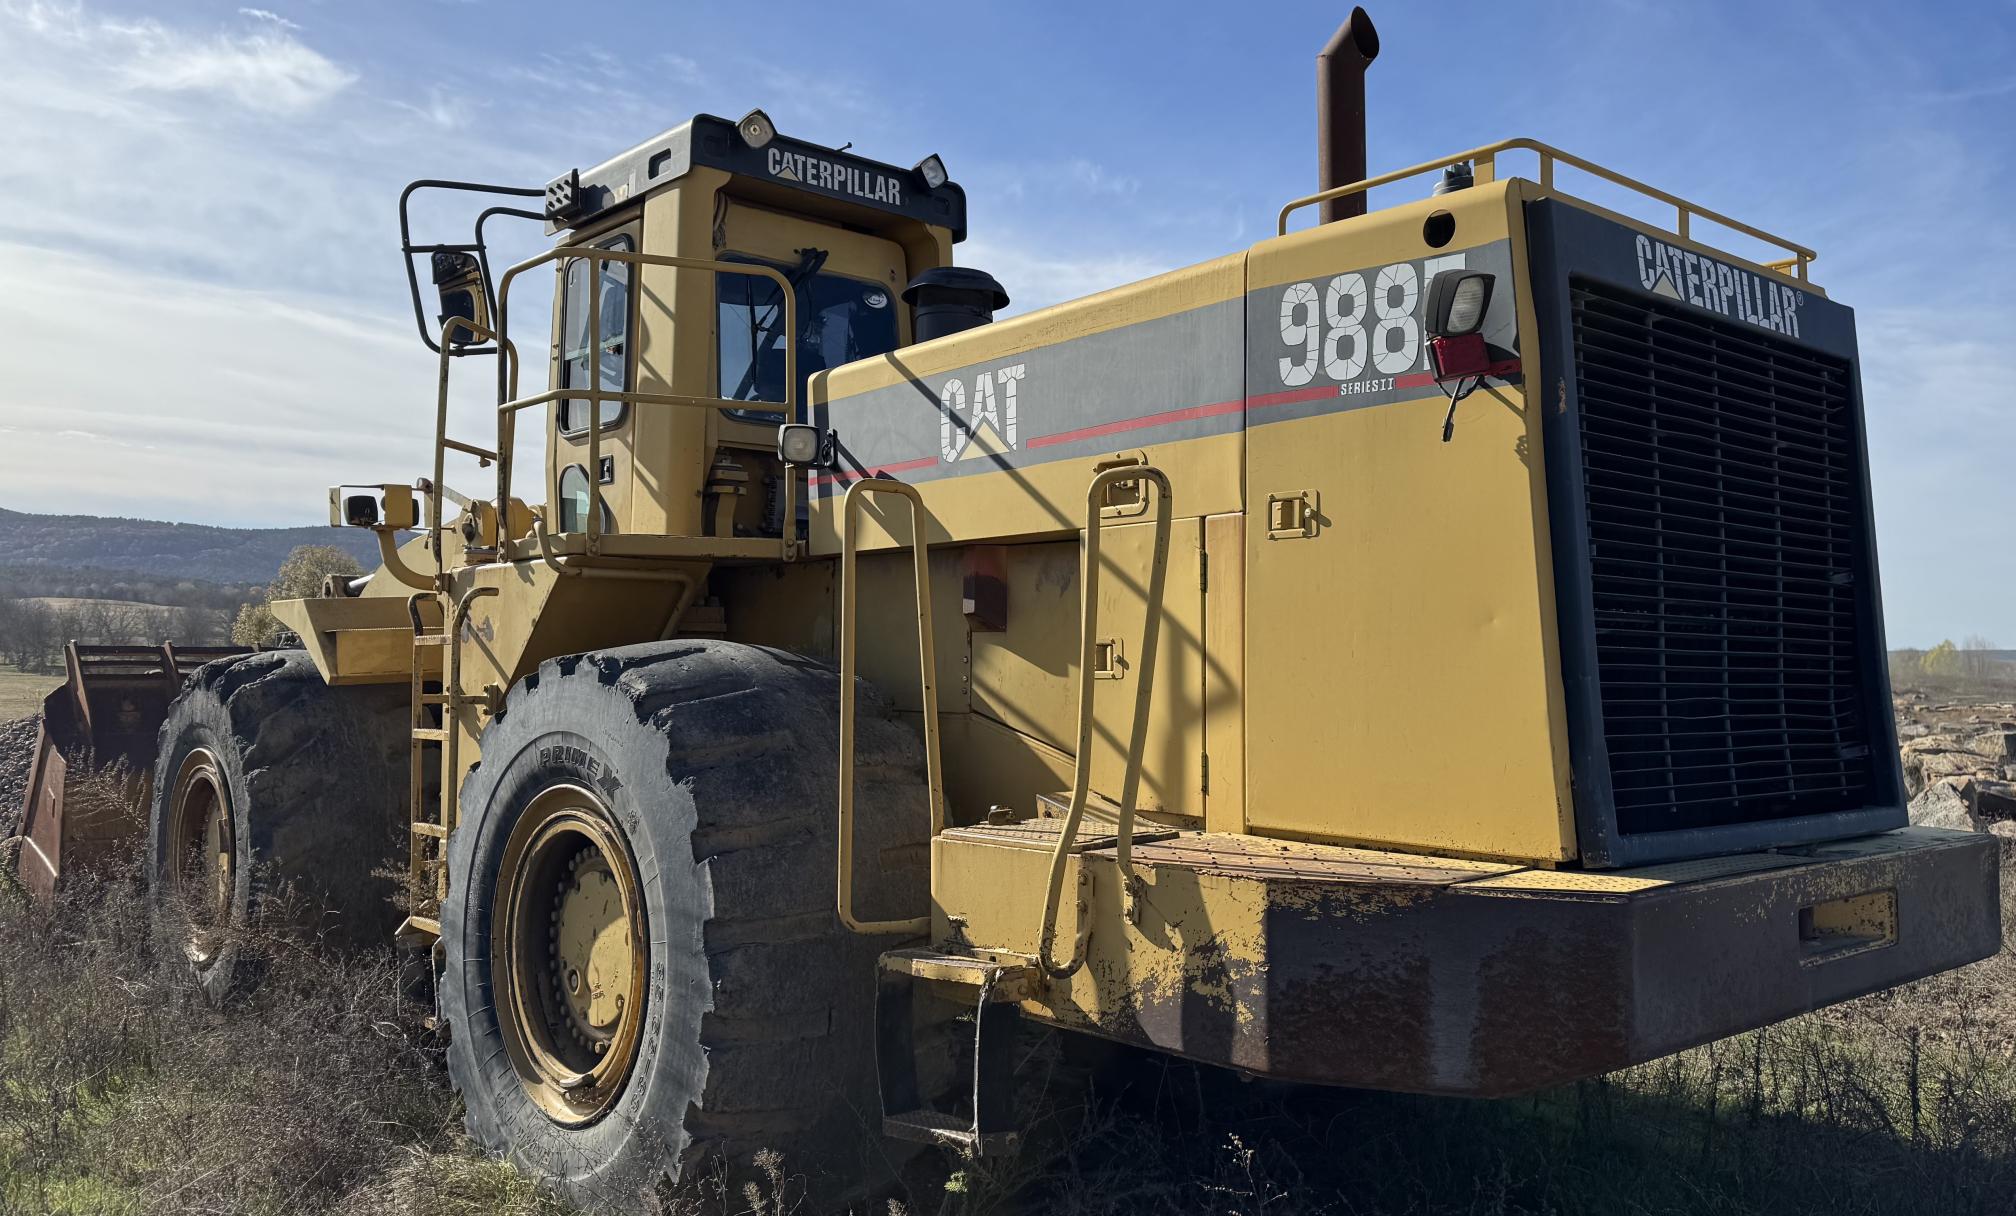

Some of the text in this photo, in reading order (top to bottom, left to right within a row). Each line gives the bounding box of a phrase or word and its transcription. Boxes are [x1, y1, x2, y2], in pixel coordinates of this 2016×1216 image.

[768, 147, 900, 205] CATERPILLAR
[940, 363, 1025, 463] CAT
[539, 744, 624, 803] PRIMEX
